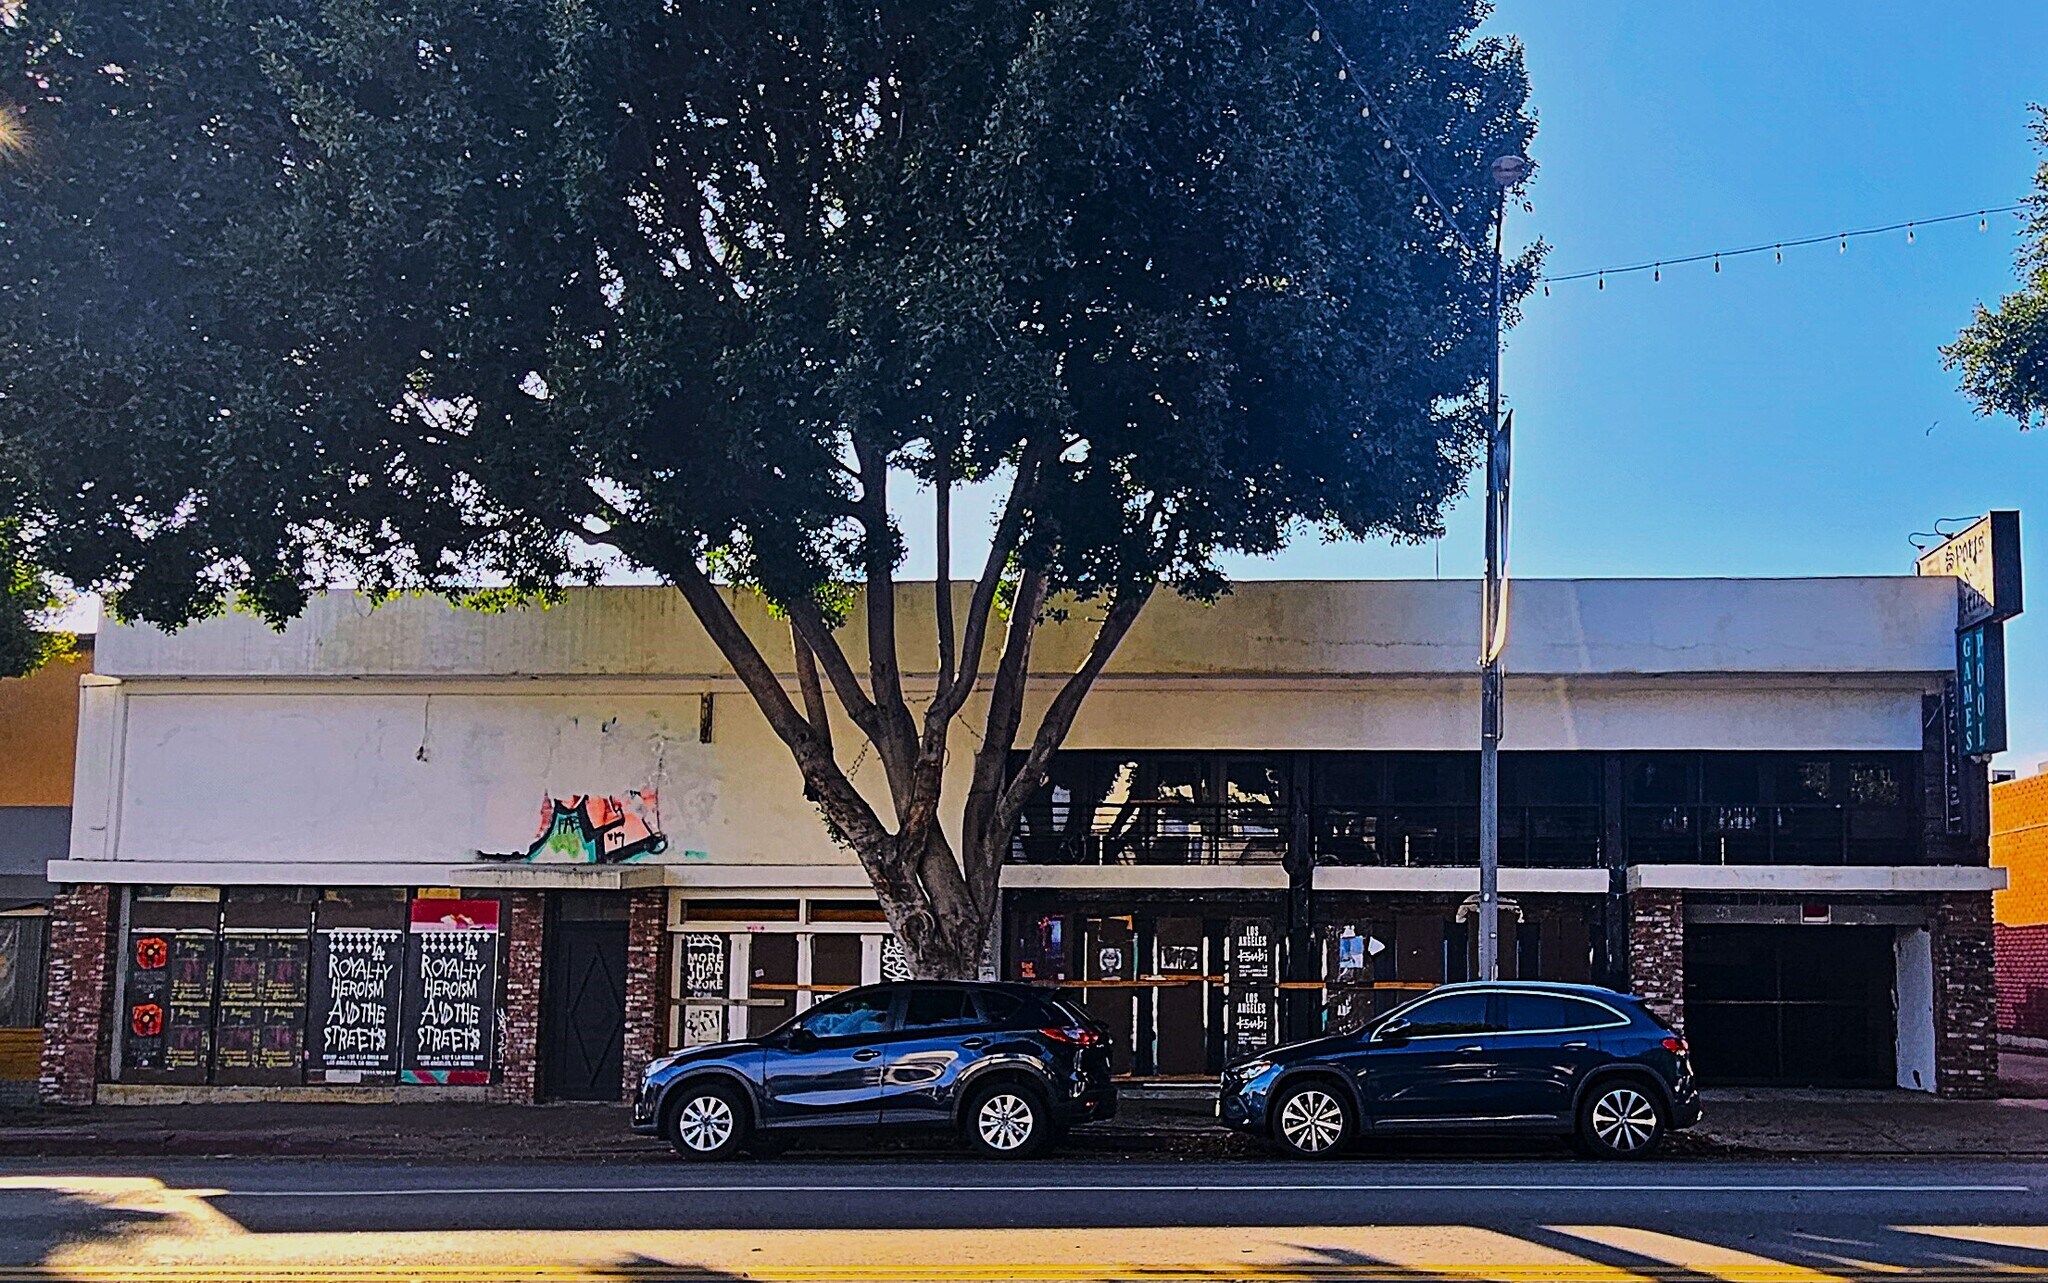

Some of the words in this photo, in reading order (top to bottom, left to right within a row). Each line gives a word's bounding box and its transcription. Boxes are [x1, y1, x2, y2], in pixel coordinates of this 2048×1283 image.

[1962, 637, 1973, 751] GAMES
[1975, 627, 1985, 746] POOL
[1246, 926, 1259, 936] LOS
[1238, 936, 1267, 947] ANGELES
[687, 953, 724, 963] MORE
[328, 954, 393, 980] ROYALTY
[421, 954, 486, 980] ROYALTY
[687, 962, 724, 974] THAN
[331, 976, 384, 999] HEROISM
[424, 976, 477, 999] HEROISM
[1246, 993, 1258, 1003] LOS
[1237, 1003, 1266, 1014] ANGELES
